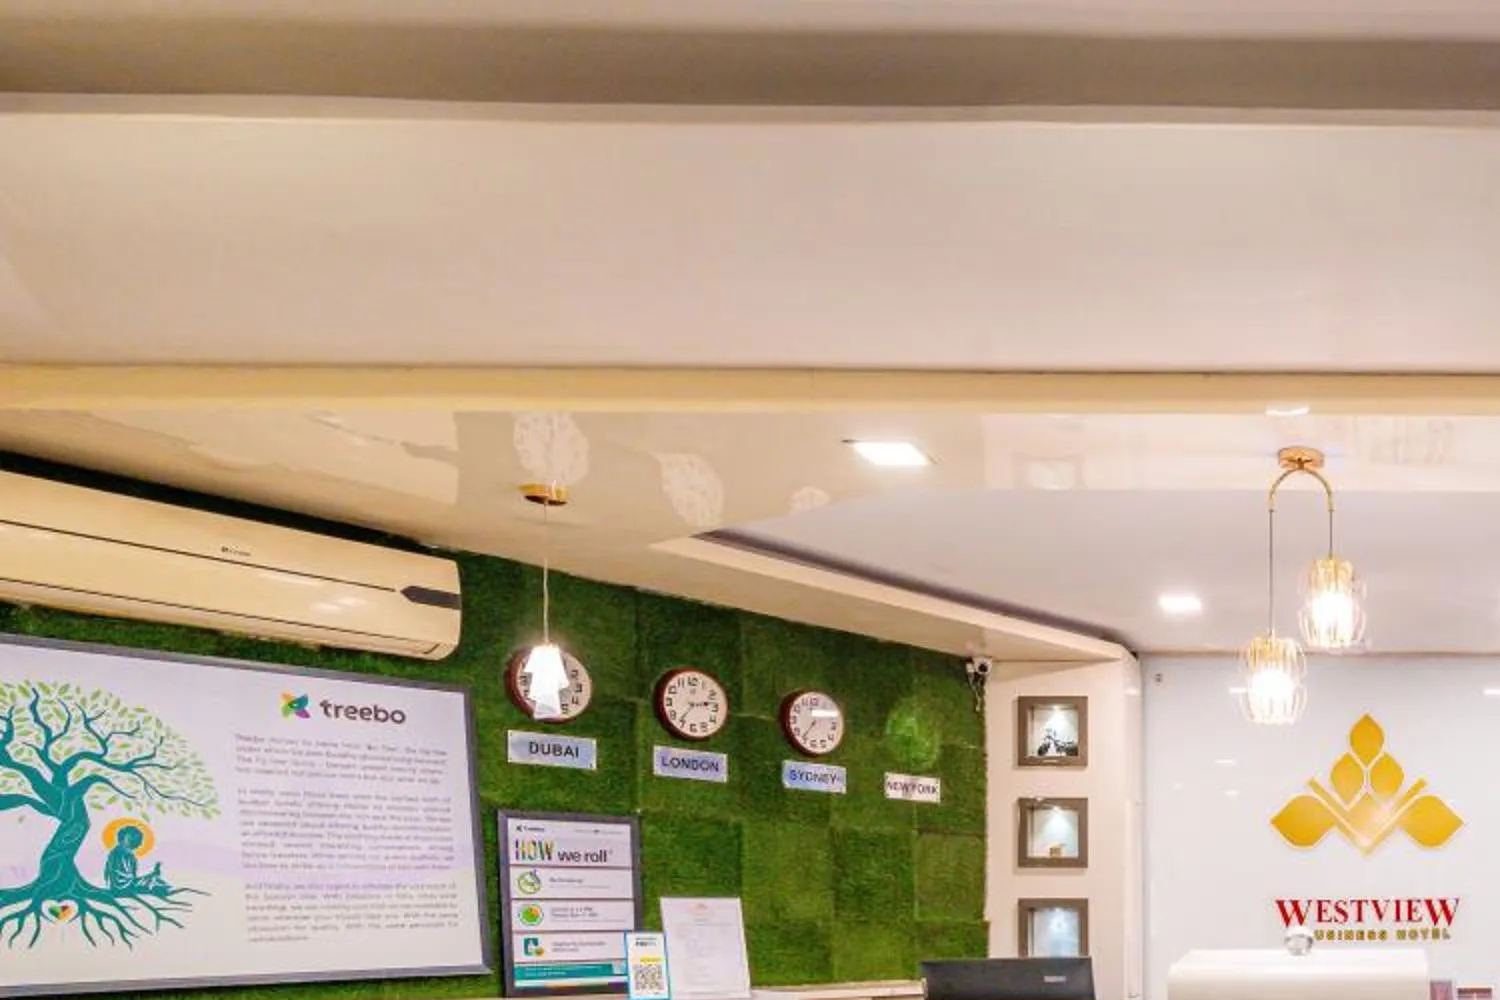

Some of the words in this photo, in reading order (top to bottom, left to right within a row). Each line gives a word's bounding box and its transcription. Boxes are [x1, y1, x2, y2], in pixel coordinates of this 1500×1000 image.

[320, 699, 407, 725] treebo
[529, 741, 580, 758] DUBAI
[661, 755, 719, 772] LONDON
[790, 769, 836, 785] SYDNEY
[557, 850, 582, 862] we
[585, 849, 608, 863] roll
[1275, 898, 1460, 928] WESTVIEW
[1314, 930, 1388, 940] USINESS
